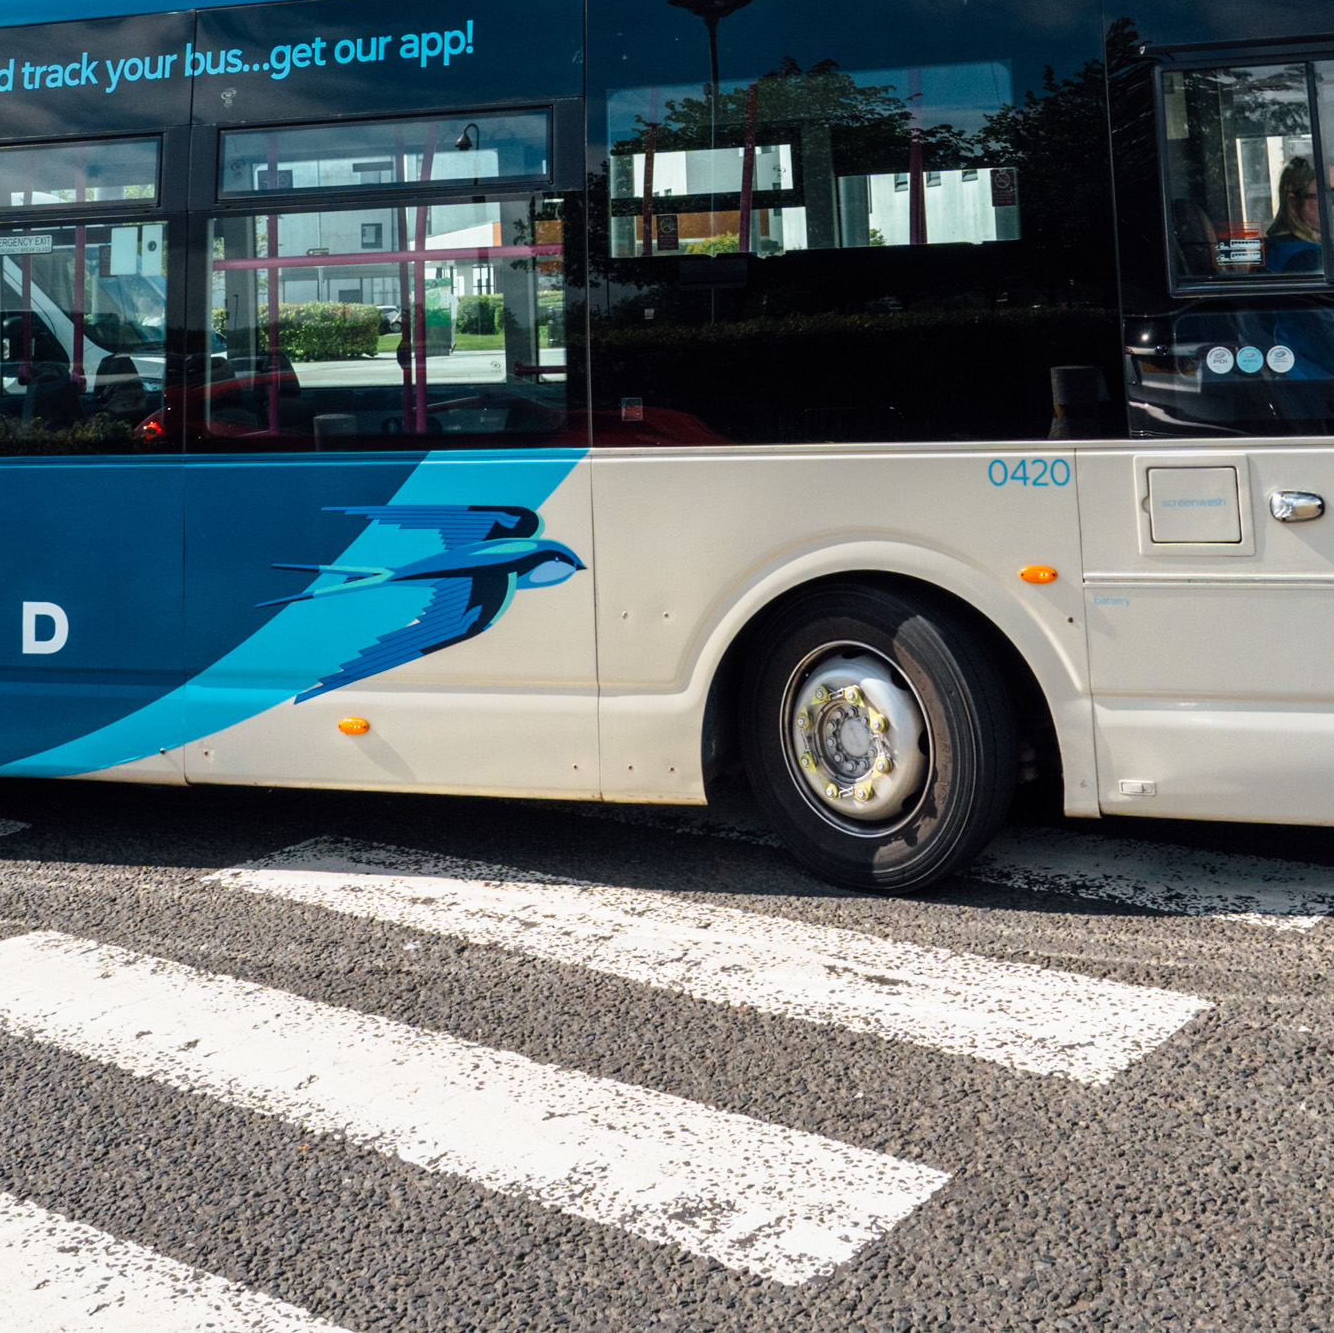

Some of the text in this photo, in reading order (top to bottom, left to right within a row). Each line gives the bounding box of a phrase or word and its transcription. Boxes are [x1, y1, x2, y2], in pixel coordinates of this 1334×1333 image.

[21, 52, 98, 90] track
[105, 52, 178, 93] your
[334, 35, 392, 64] our
[400, 19, 475, 68] app!
[34, 236, 50, 246] EXIT
[988, 459, 1071, 487] 0420
[1162, 497, 1227, 508] screenwash
[1093, 595, 1131, 607] battery
